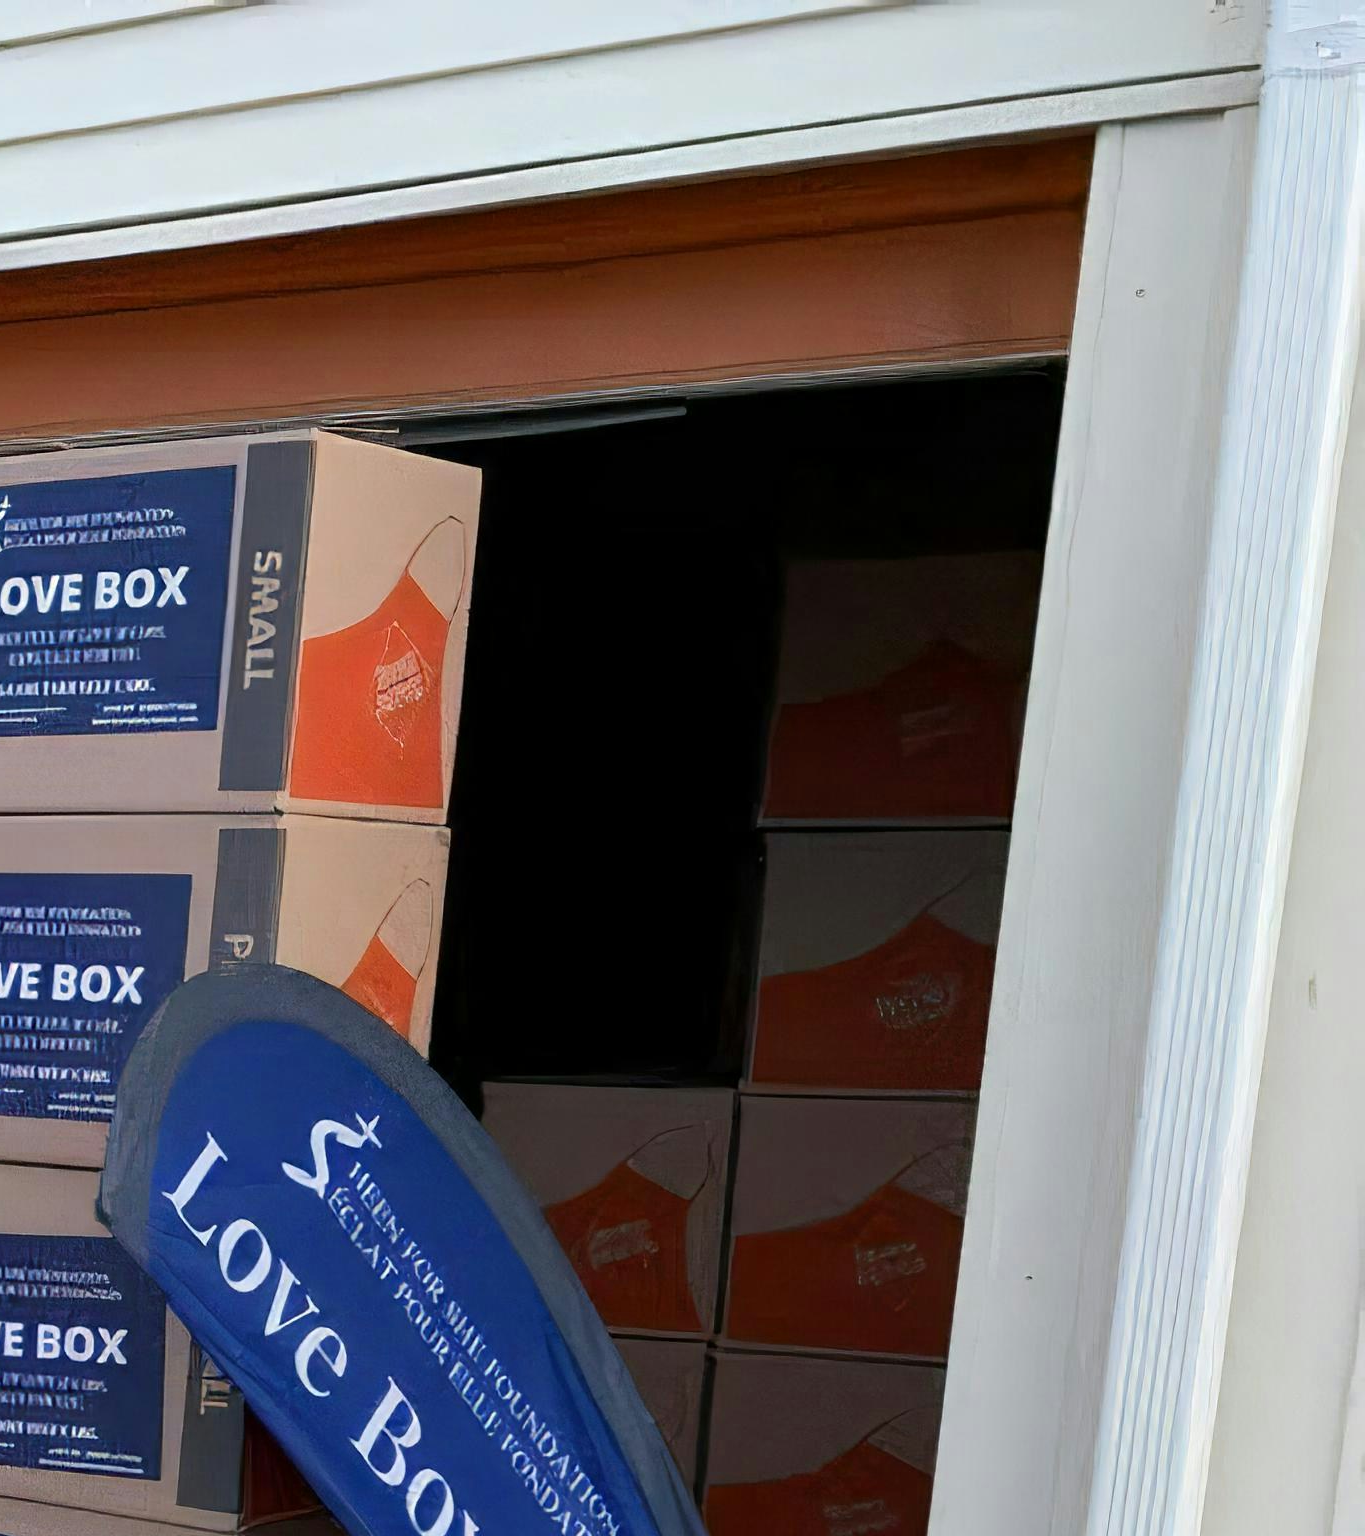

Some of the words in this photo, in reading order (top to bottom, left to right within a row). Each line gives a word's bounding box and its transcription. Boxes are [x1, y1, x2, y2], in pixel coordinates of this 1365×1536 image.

[94, 566, 189, 610] BOX
[243, 550, 283, 690] SMALL
[52, 963, 145, 1005] BOX
[161, 1131, 348, 1398] Love
[37, 1324, 128, 1366] BOX
[393, 1282, 450, 1366] POUR
